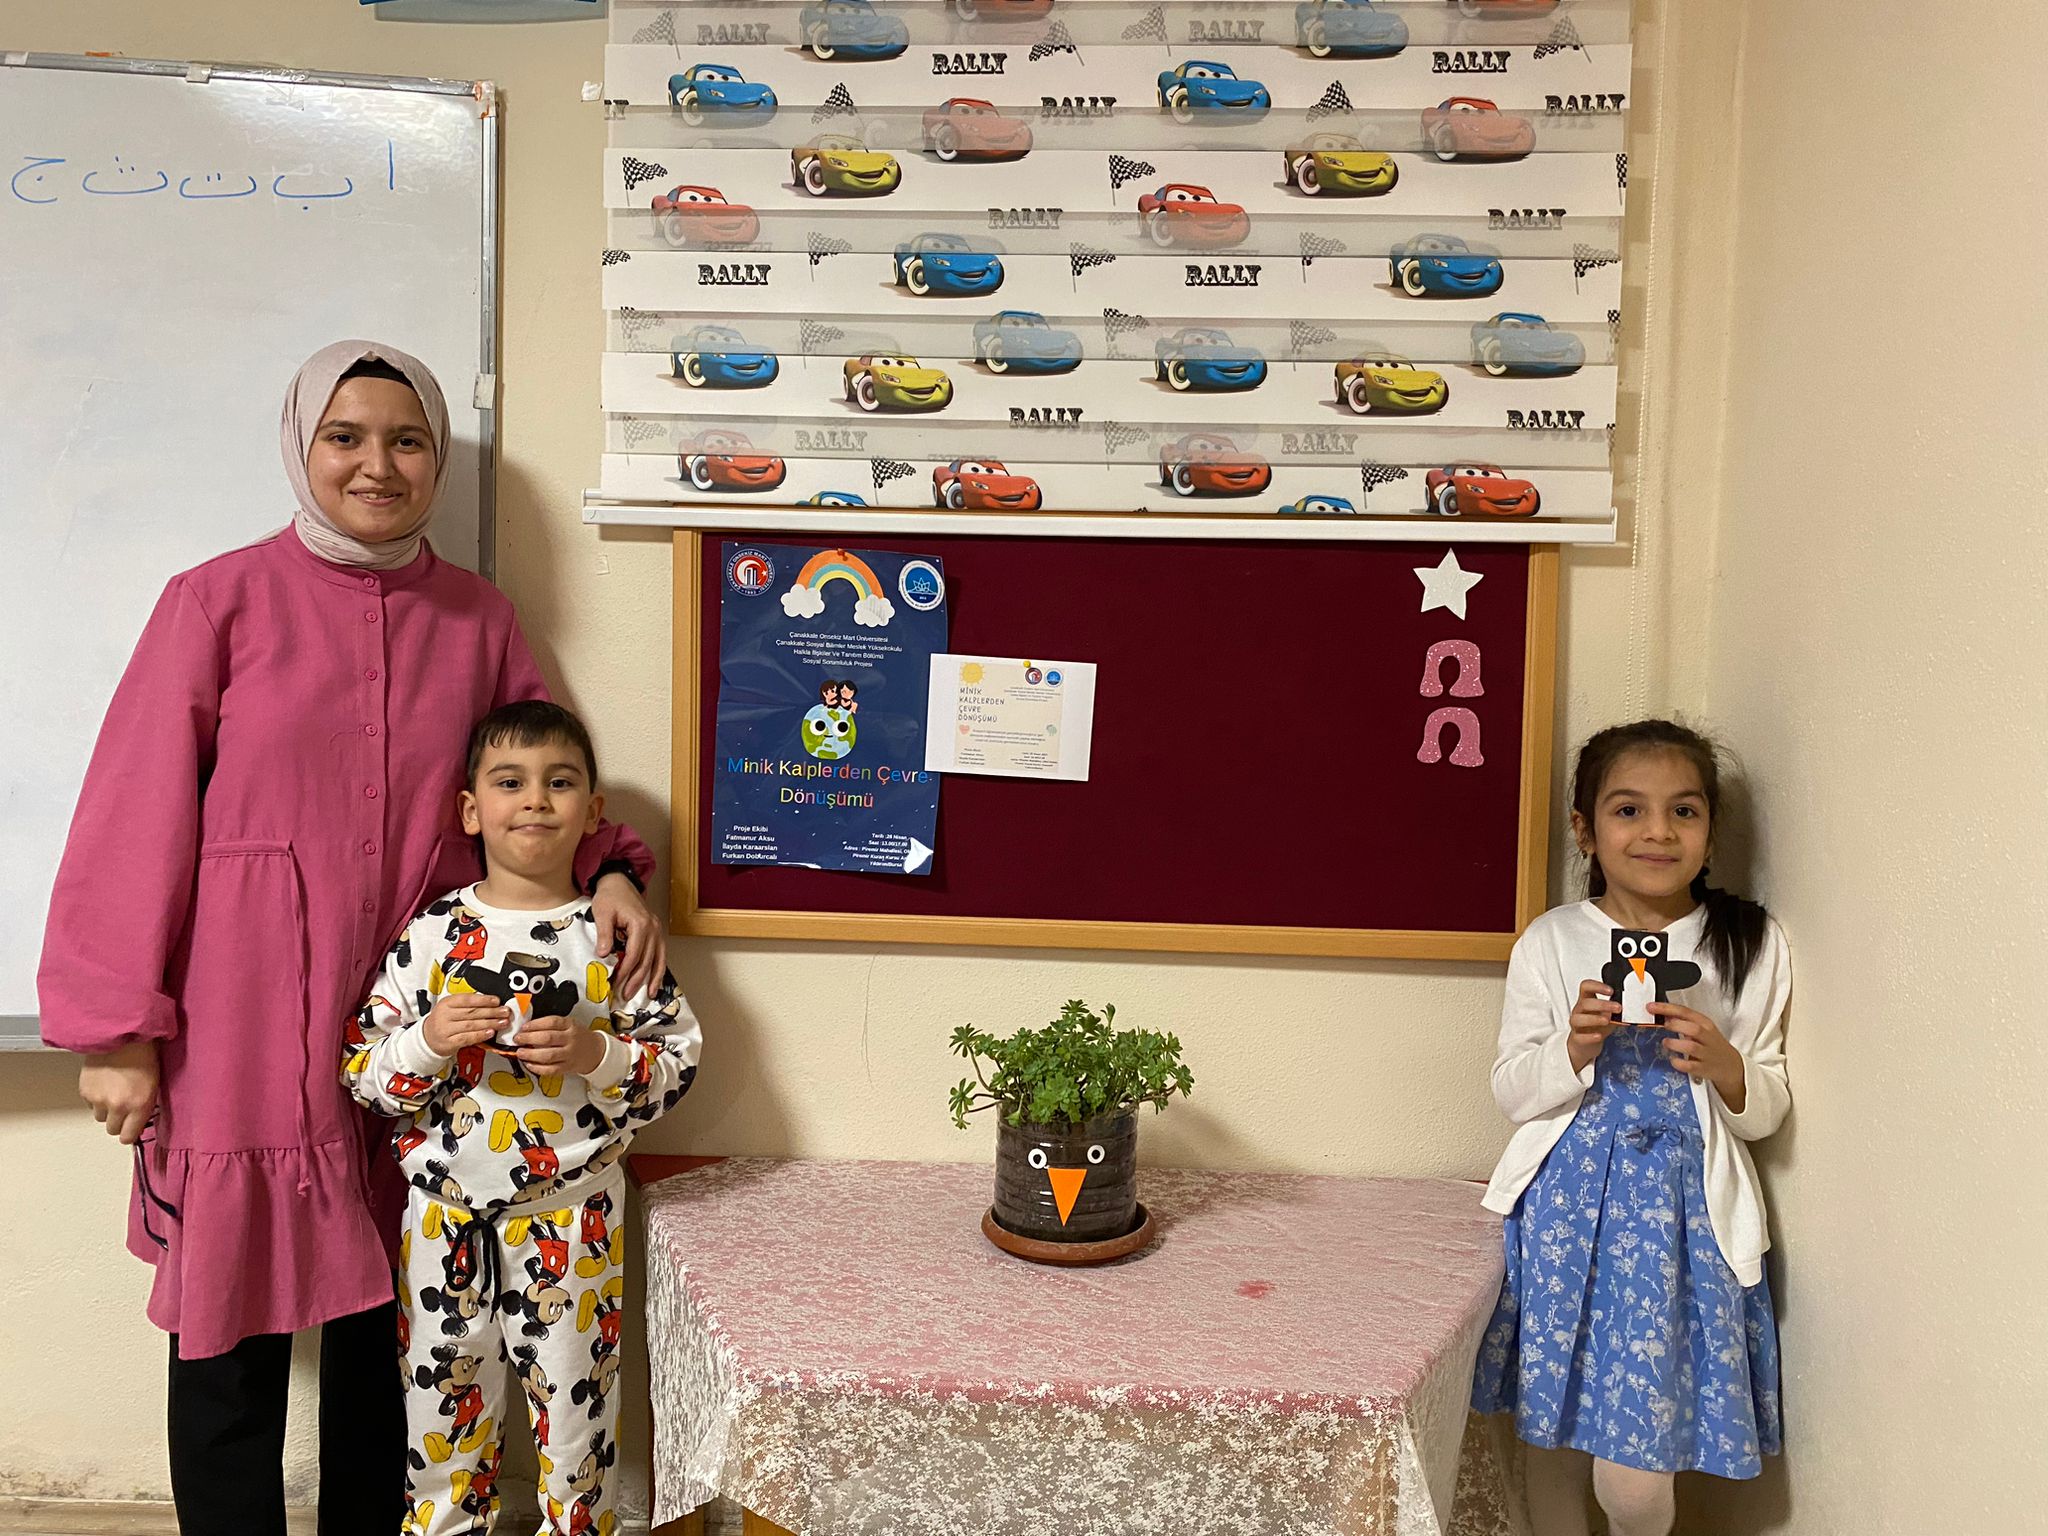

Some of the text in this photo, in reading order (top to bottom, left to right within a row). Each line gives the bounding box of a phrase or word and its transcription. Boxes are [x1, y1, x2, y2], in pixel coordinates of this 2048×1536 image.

[697, 24, 771, 46] RALLY
[1189, 20, 1265, 42] RALLY
[932, 52, 1007, 75] RALLY
[1432, 50, 1511, 73] RALLY
[1041, 96, 1117, 118] RALLY
[1544, 93, 1625, 116] RALLY
[12, 156, 66, 203] ج
[82, 155, 168, 194] ث
[179, 172, 257, 199] ت
[273, 174, 353, 210] ب
[988, 208, 1063, 230] RALLY
[1487, 208, 1566, 231] RALLY
[698, 264, 771, 286] RALLY
[1184, 264, 1262, 286] RALLY
[1008, 407, 1084, 429] RALLY
[1506, 409, 1585, 430] RALLY
[794, 429, 868, 452] RALLY
[1281, 432, 1358, 455] RALLY
[806, 641, 825, 649] Sosyal
[959, 696, 1005, 705] KALPLERDEN
[960, 687, 982, 695] MİNİK
[958, 705, 981, 713] ÇEVRE
[728, 758, 928, 785] Minik Kalplerden Çevre
[780, 788, 873, 809] Dönüşümü
[733, 825, 751, 833] Proje
